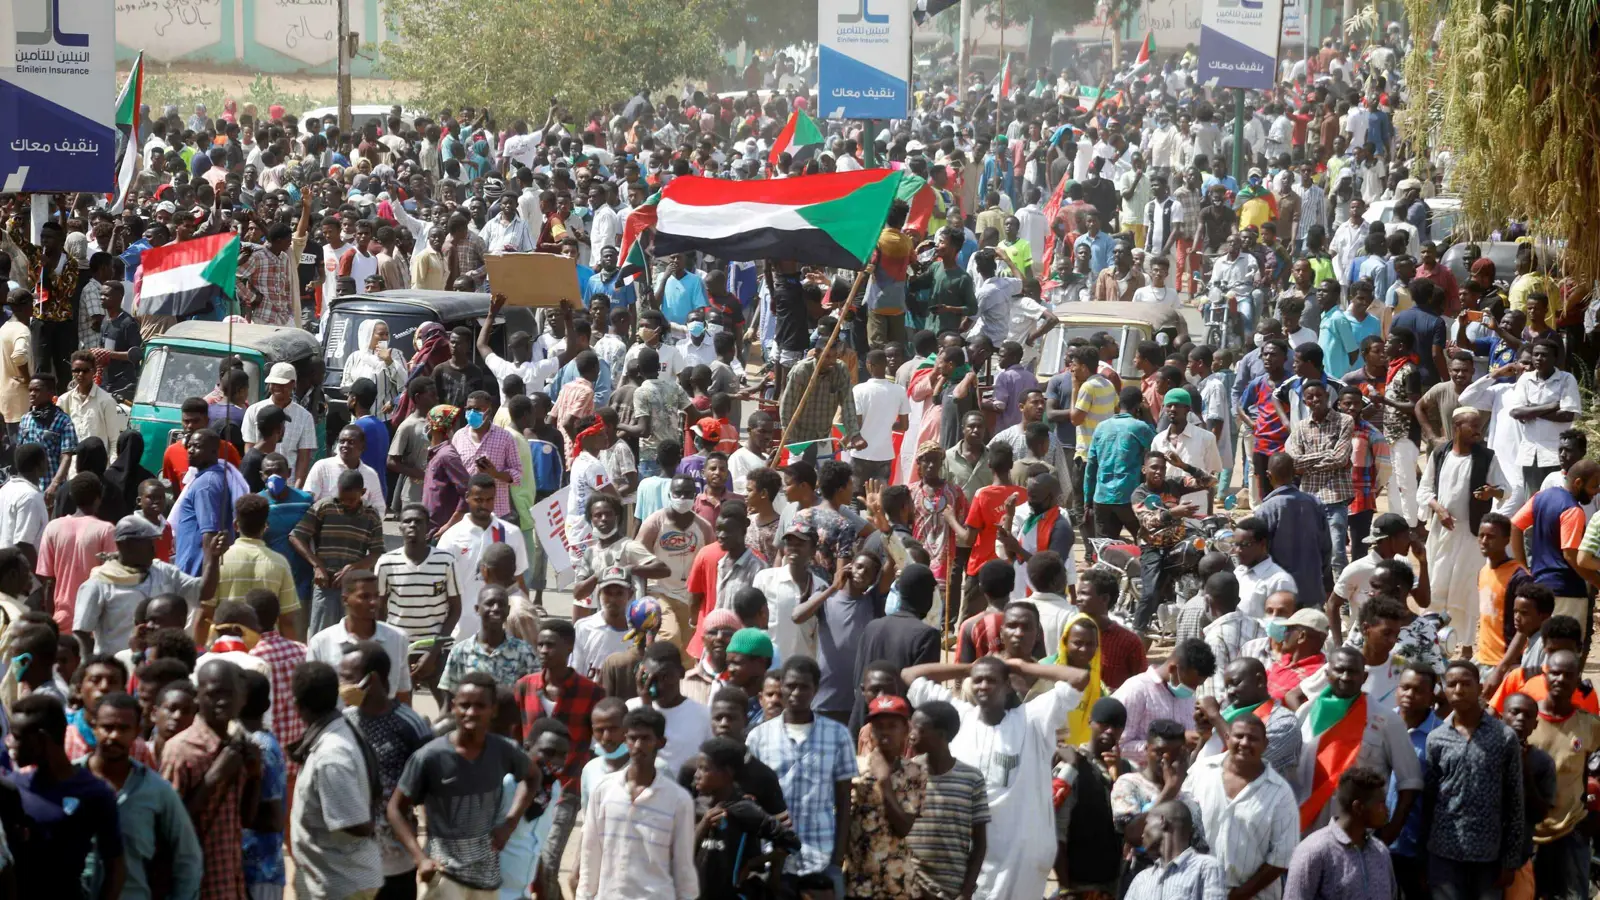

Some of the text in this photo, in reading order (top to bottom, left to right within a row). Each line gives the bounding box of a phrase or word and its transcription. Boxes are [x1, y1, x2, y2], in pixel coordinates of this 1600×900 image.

[15, 48, 90, 64] النيلين للتأمين
[16, 64, 90, 75] Elnilein Insurance
[1208, 61, 1264, 73] بنقيف معاك
[831, 87, 896, 100] بنقيف معاك
[10, 138, 99, 156] بنقيف معاك
